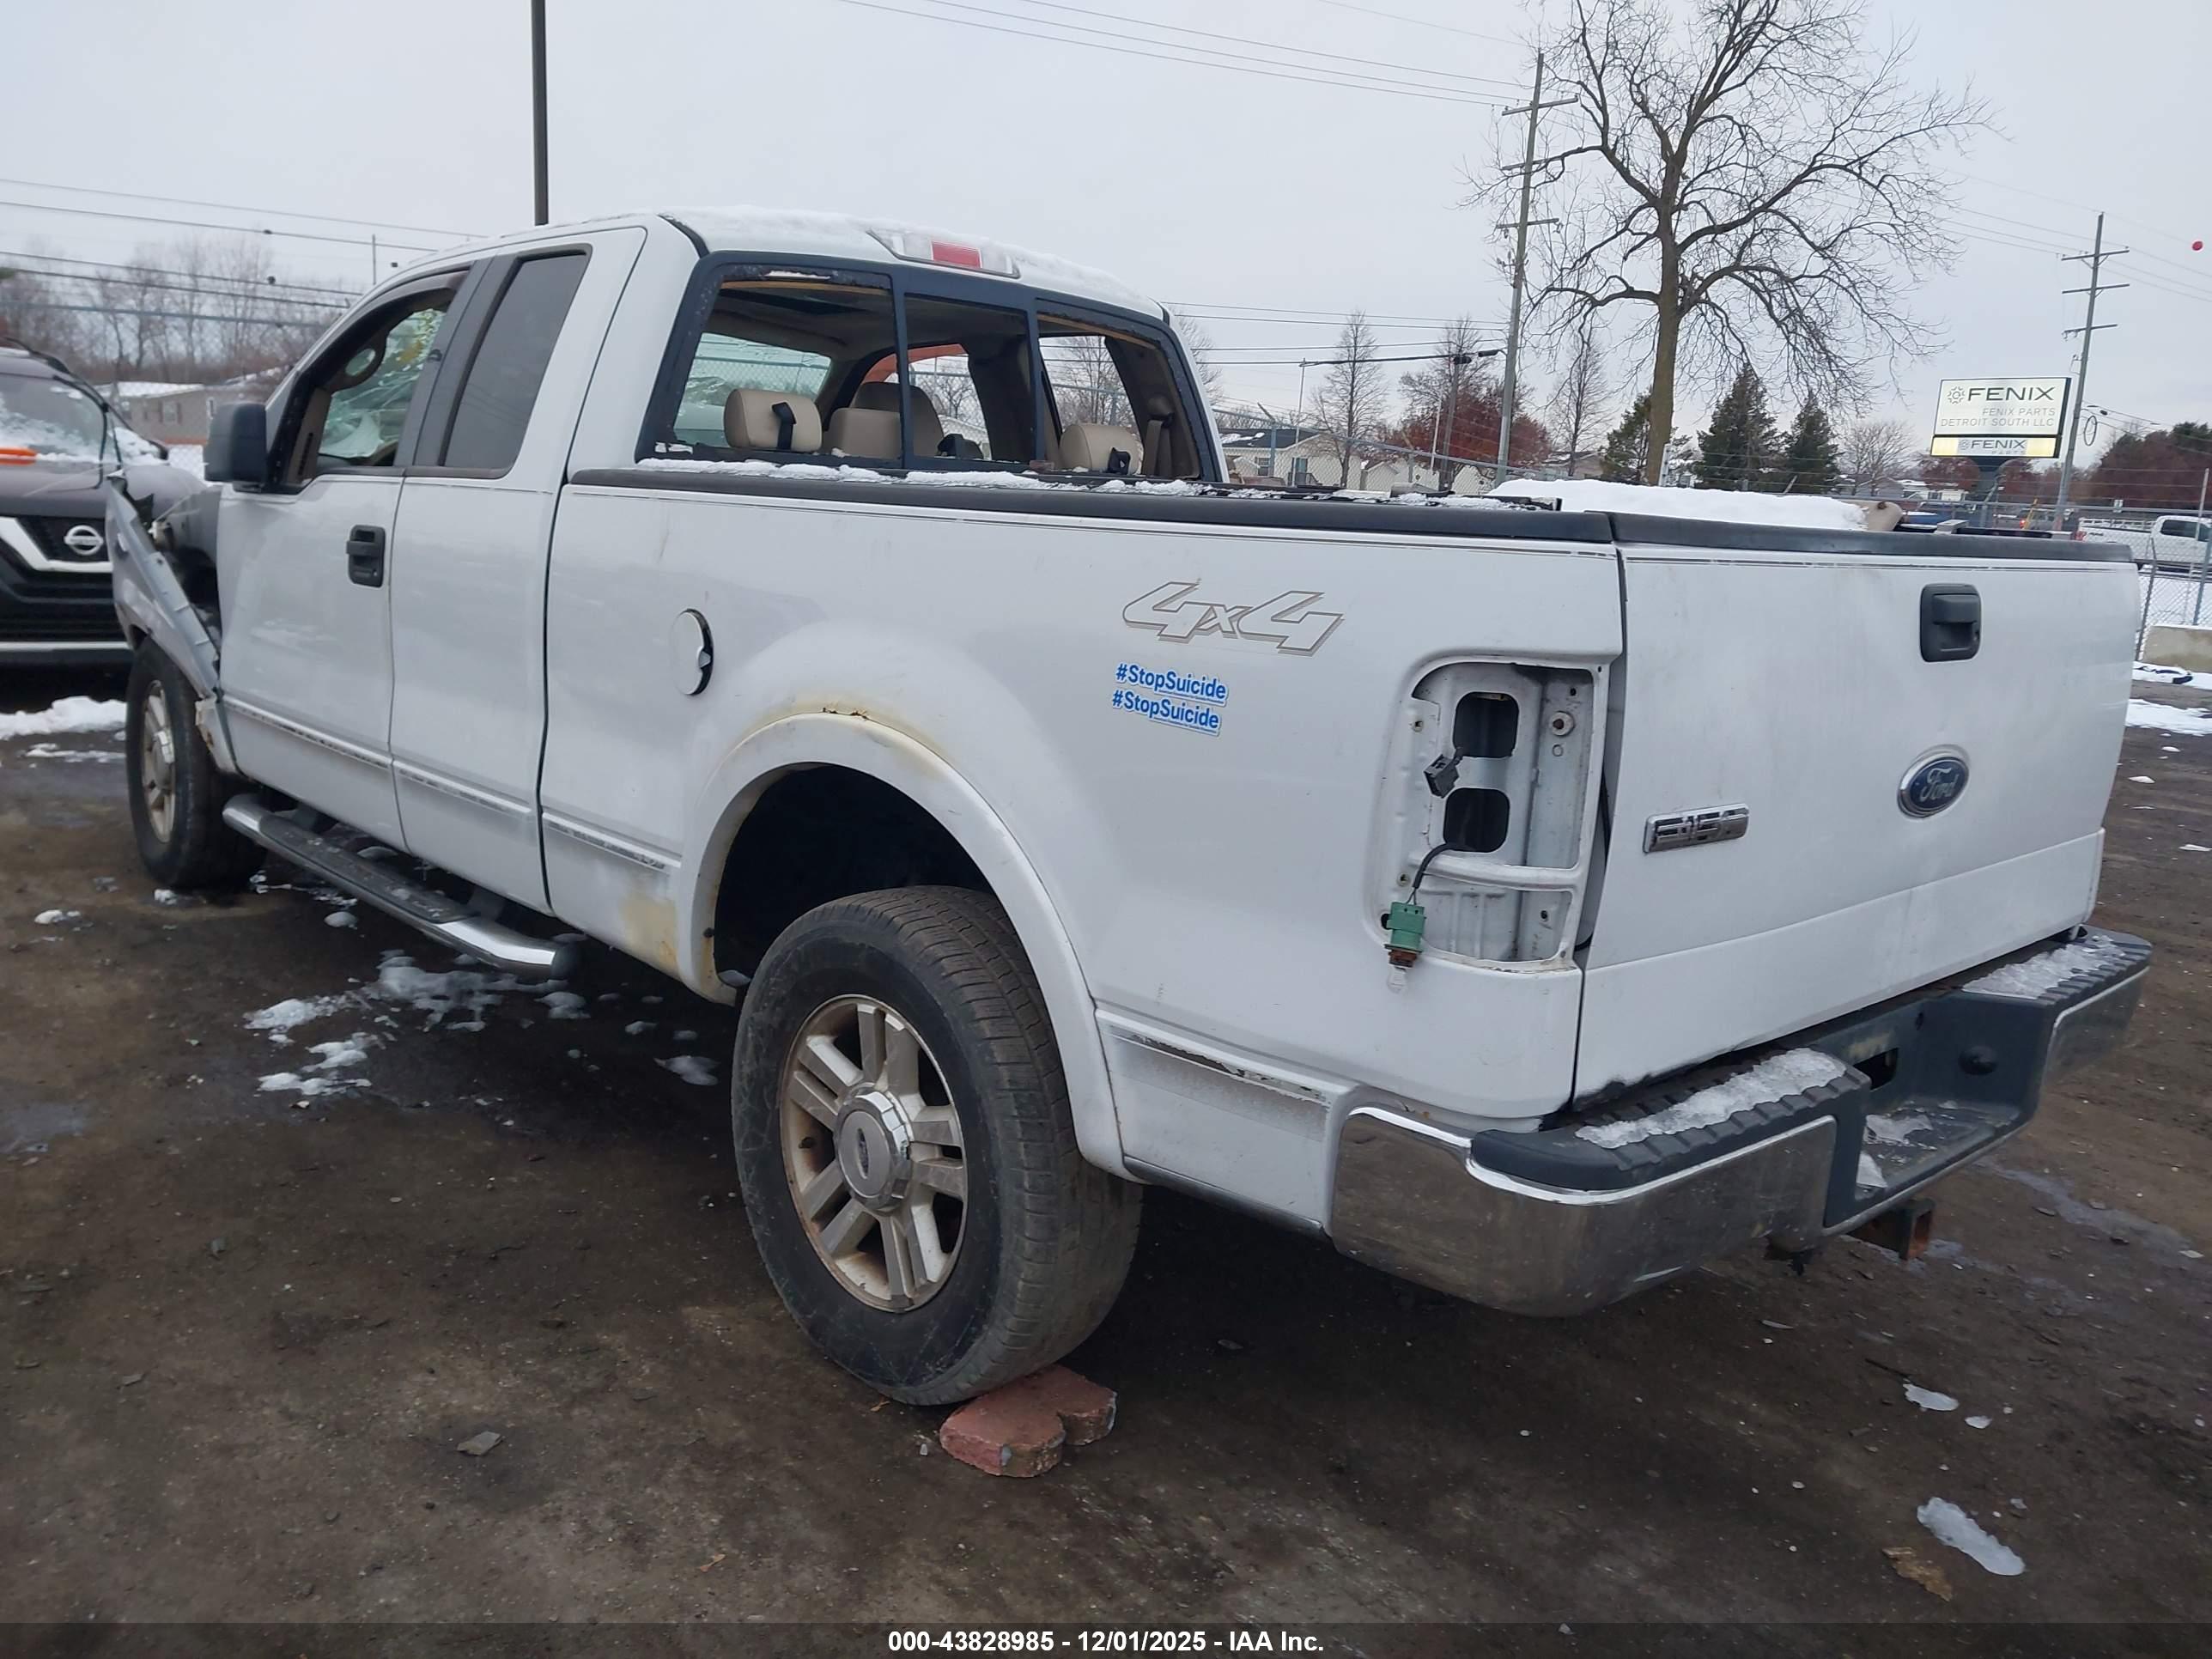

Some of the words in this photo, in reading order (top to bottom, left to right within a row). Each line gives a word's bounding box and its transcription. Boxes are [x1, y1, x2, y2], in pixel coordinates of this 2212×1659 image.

[1967, 386, 2056, 402] FENIX
[1941, 418, 1988, 427] DETROIT
[1991, 417, 2030, 427] SOUTH
[2033, 418, 2055, 427] LLC
[1982, 407, 2014, 416] FENIX
[2018, 407, 2056, 416] PARTS
[1971, 439, 2027, 449] FENIX
[1122, 581, 1346, 657] 4x4
[1116, 663, 1226, 700] #StopSuicide
[1112, 690, 1219, 729] #StopSuicide
[1920, 768, 1960, 802] Ford
